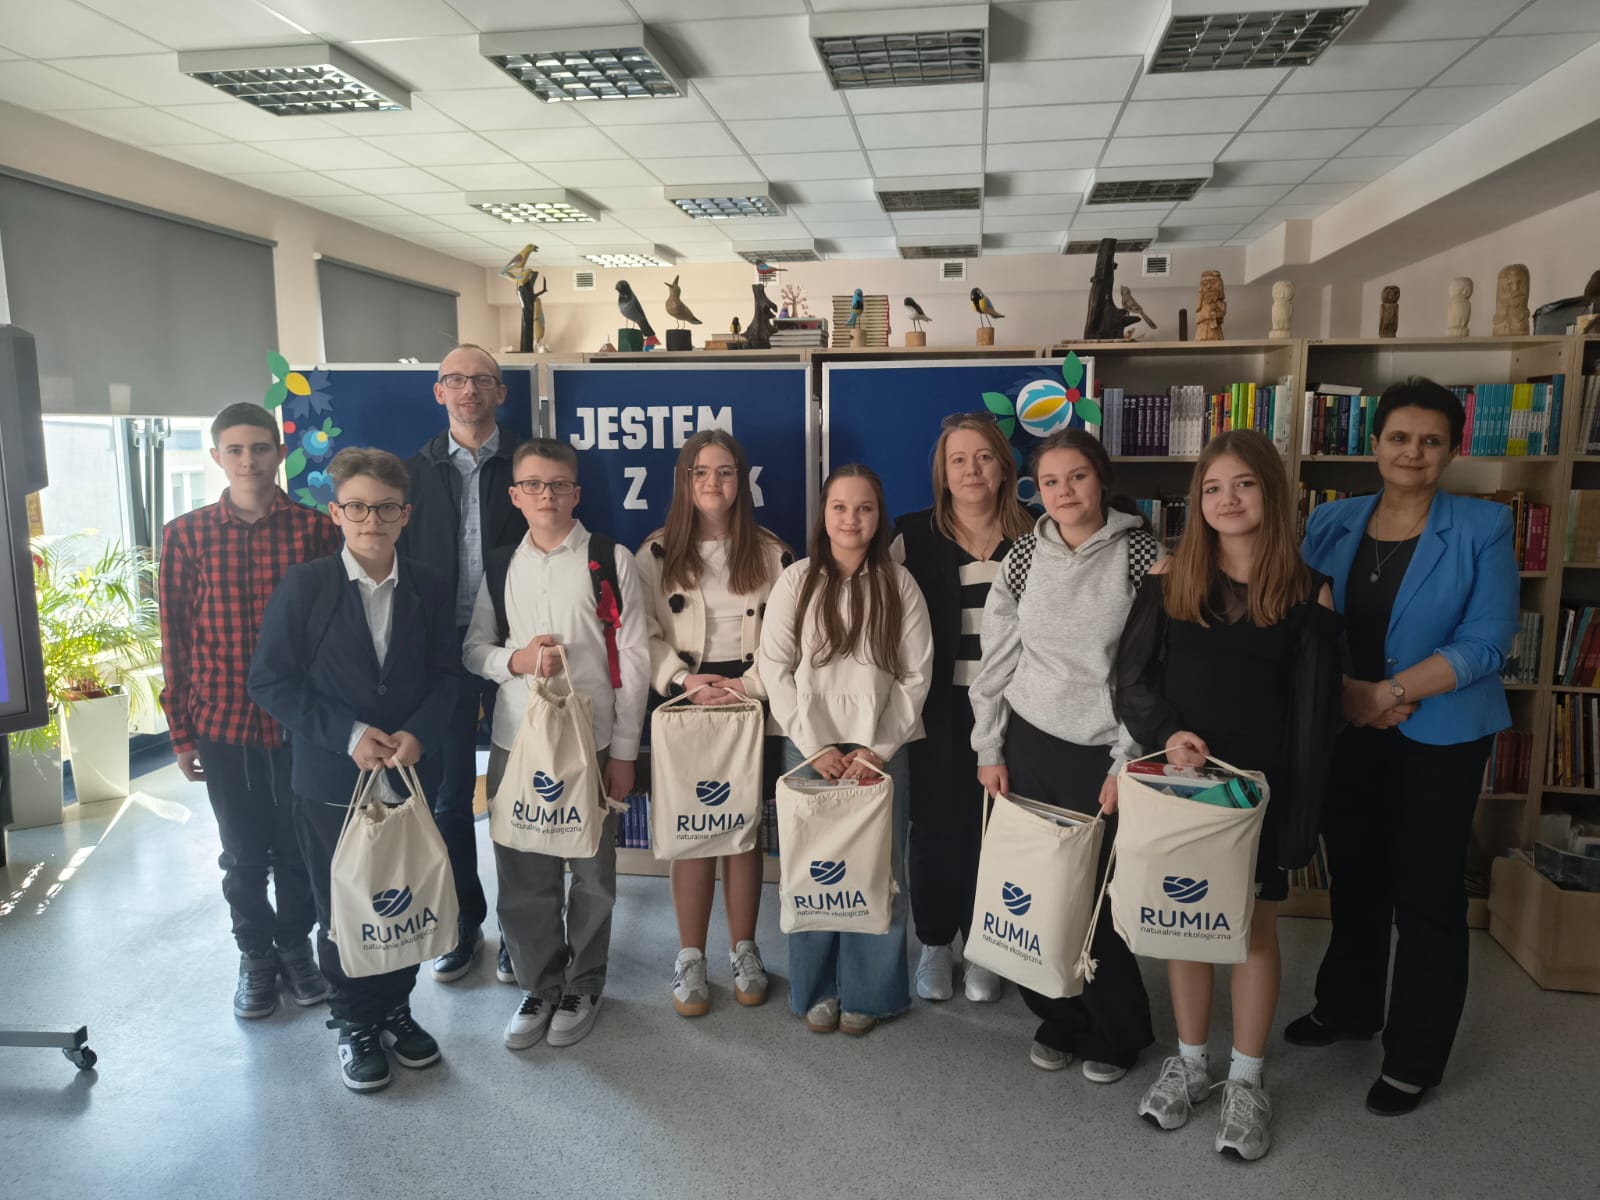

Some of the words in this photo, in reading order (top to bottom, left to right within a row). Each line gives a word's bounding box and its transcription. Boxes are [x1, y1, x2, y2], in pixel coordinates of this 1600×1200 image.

[570, 406, 733, 450] JESTEM
[623, 466, 648, 510] Z
[513, 800, 581, 825] RUMIA
[677, 813, 745, 832] RUMIA
[676, 831, 709, 841] naturalnie
[794, 890, 867, 910] RUMIA
[362, 907, 438, 943] RUMIA
[1141, 906, 1231, 931] RUMIA
[983, 911, 1041, 956] RUMIA
[1140, 926, 1181, 937] naturalnie
[1183, 929, 1231, 940] ekologiczna
